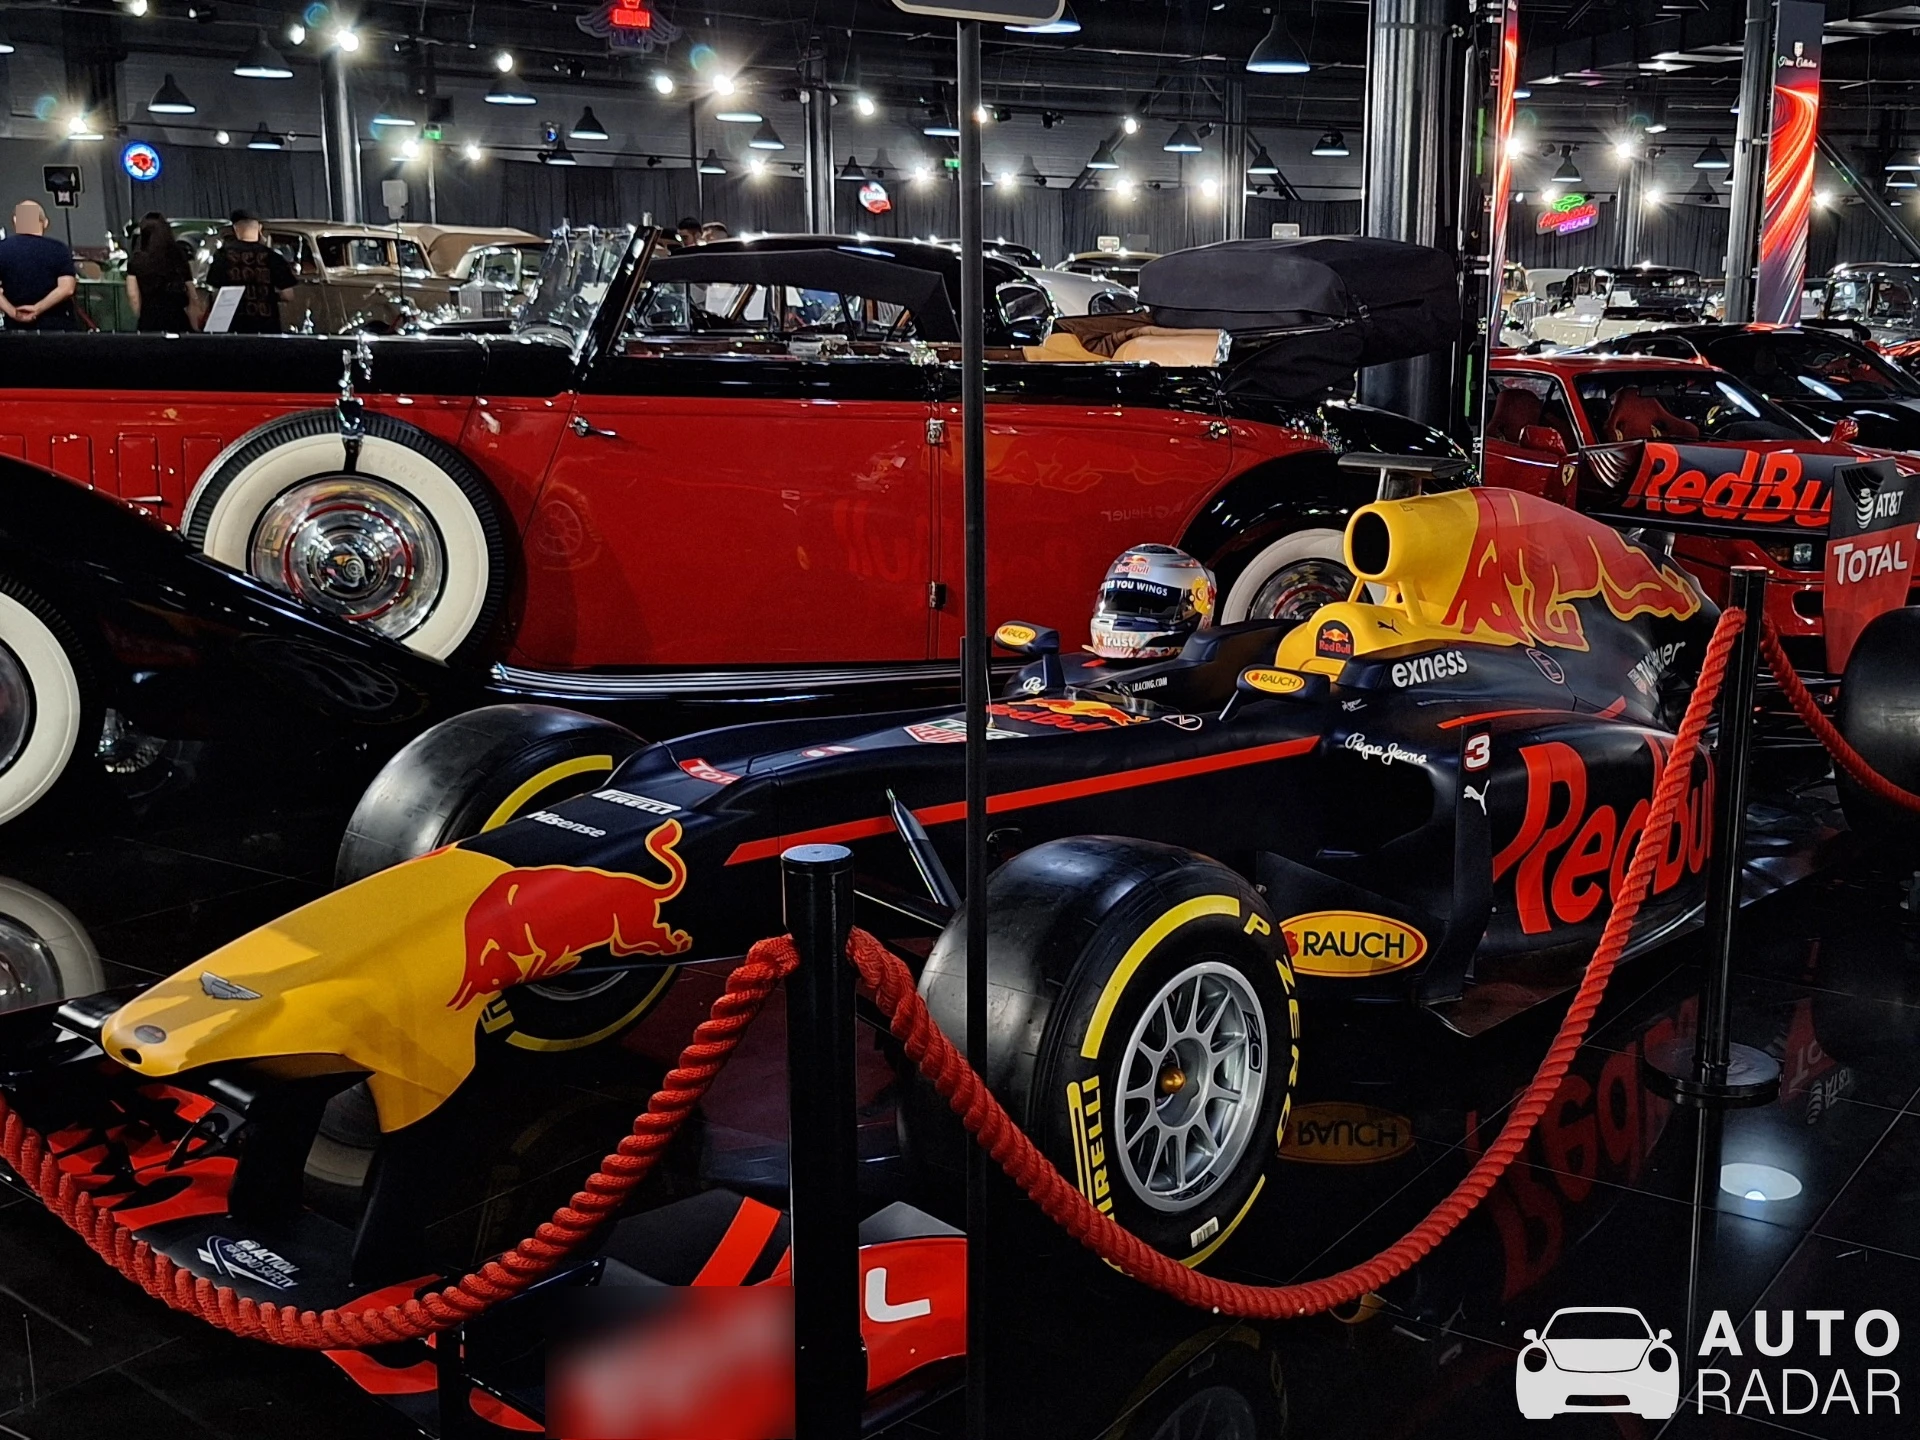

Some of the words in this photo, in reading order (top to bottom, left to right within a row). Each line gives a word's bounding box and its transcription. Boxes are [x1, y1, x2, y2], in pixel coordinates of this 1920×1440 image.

[1874, 490, 1904, 520] AT&T
[1833, 540, 1908, 586] TOTAL
[1116, 580, 1135, 590] YOU
[1136, 582, 1169, 597] WINGS
[1102, 635, 1135, 648] Trust
[1259, 672, 1298, 687] RAUCH
[1391, 650, 1468, 688] exness
[1131, 676, 1168, 693] LRACING.COM
[1345, 732, 1383, 760] Pepe
[1381, 742, 1428, 765] Jeans
[1464, 732, 1491, 772] 3
[592, 789, 682, 815] PIRELLI
[526, 810, 607, 838] Hisense
[1302, 930, 1406, 959] RAUCH
[231, 1251, 264, 1269] ROAD
[255, 1265, 299, 1288] SAFETY
[249, 1248, 300, 1274] ACTION
